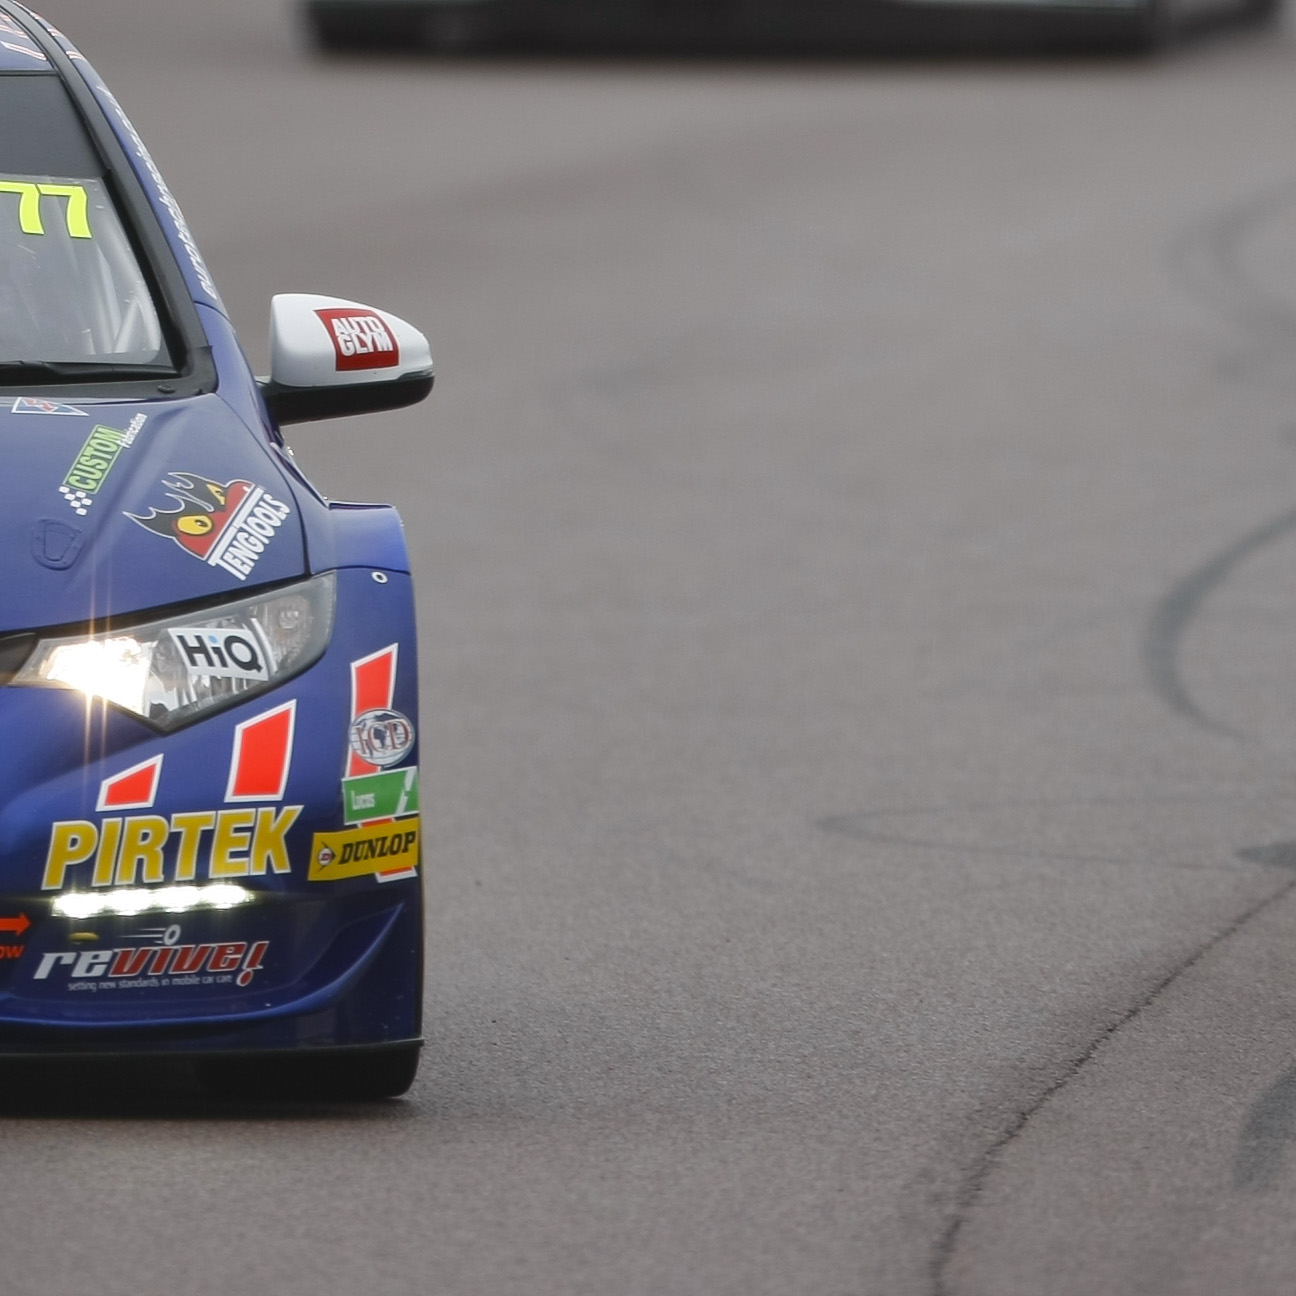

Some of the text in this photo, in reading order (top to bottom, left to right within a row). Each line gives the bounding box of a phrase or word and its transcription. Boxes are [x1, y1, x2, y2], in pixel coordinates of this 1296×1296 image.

[331, 316, 385, 336] AUTO
[337, 331, 393, 357] GLYM
[68, 427, 125, 490] CUSTOM
[176, 634, 262, 673] HiQ
[41, 805, 303, 891] PIRTEK
[338, 830, 417, 865] DUNLOP
[68, 980, 96, 993] setting
[98, 981, 116, 990] new
[119, 977, 159, 990] standards
[172, 974, 200, 986] mobile
